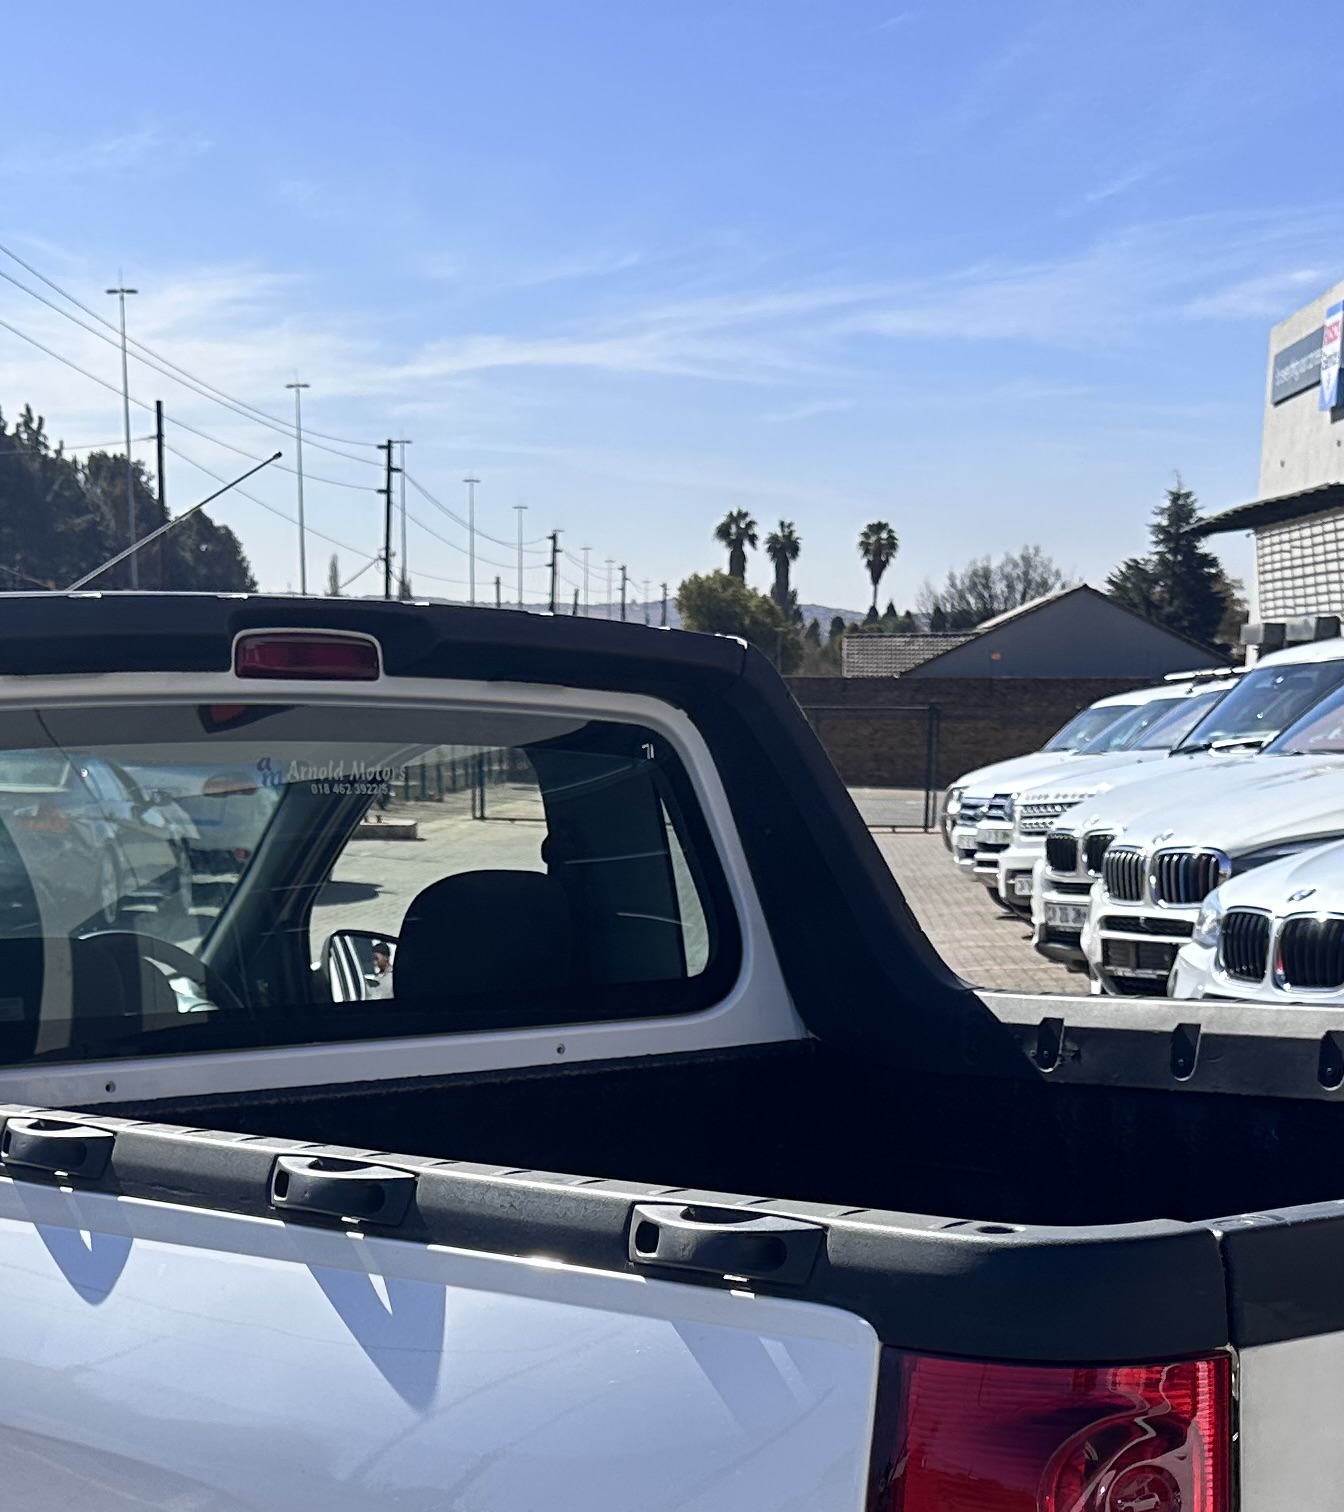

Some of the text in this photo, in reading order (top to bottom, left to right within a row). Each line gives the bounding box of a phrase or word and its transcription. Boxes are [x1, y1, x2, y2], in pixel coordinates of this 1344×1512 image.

[287, 759, 407, 782] Arnold Motors
[311, 783, 331, 795] 018
